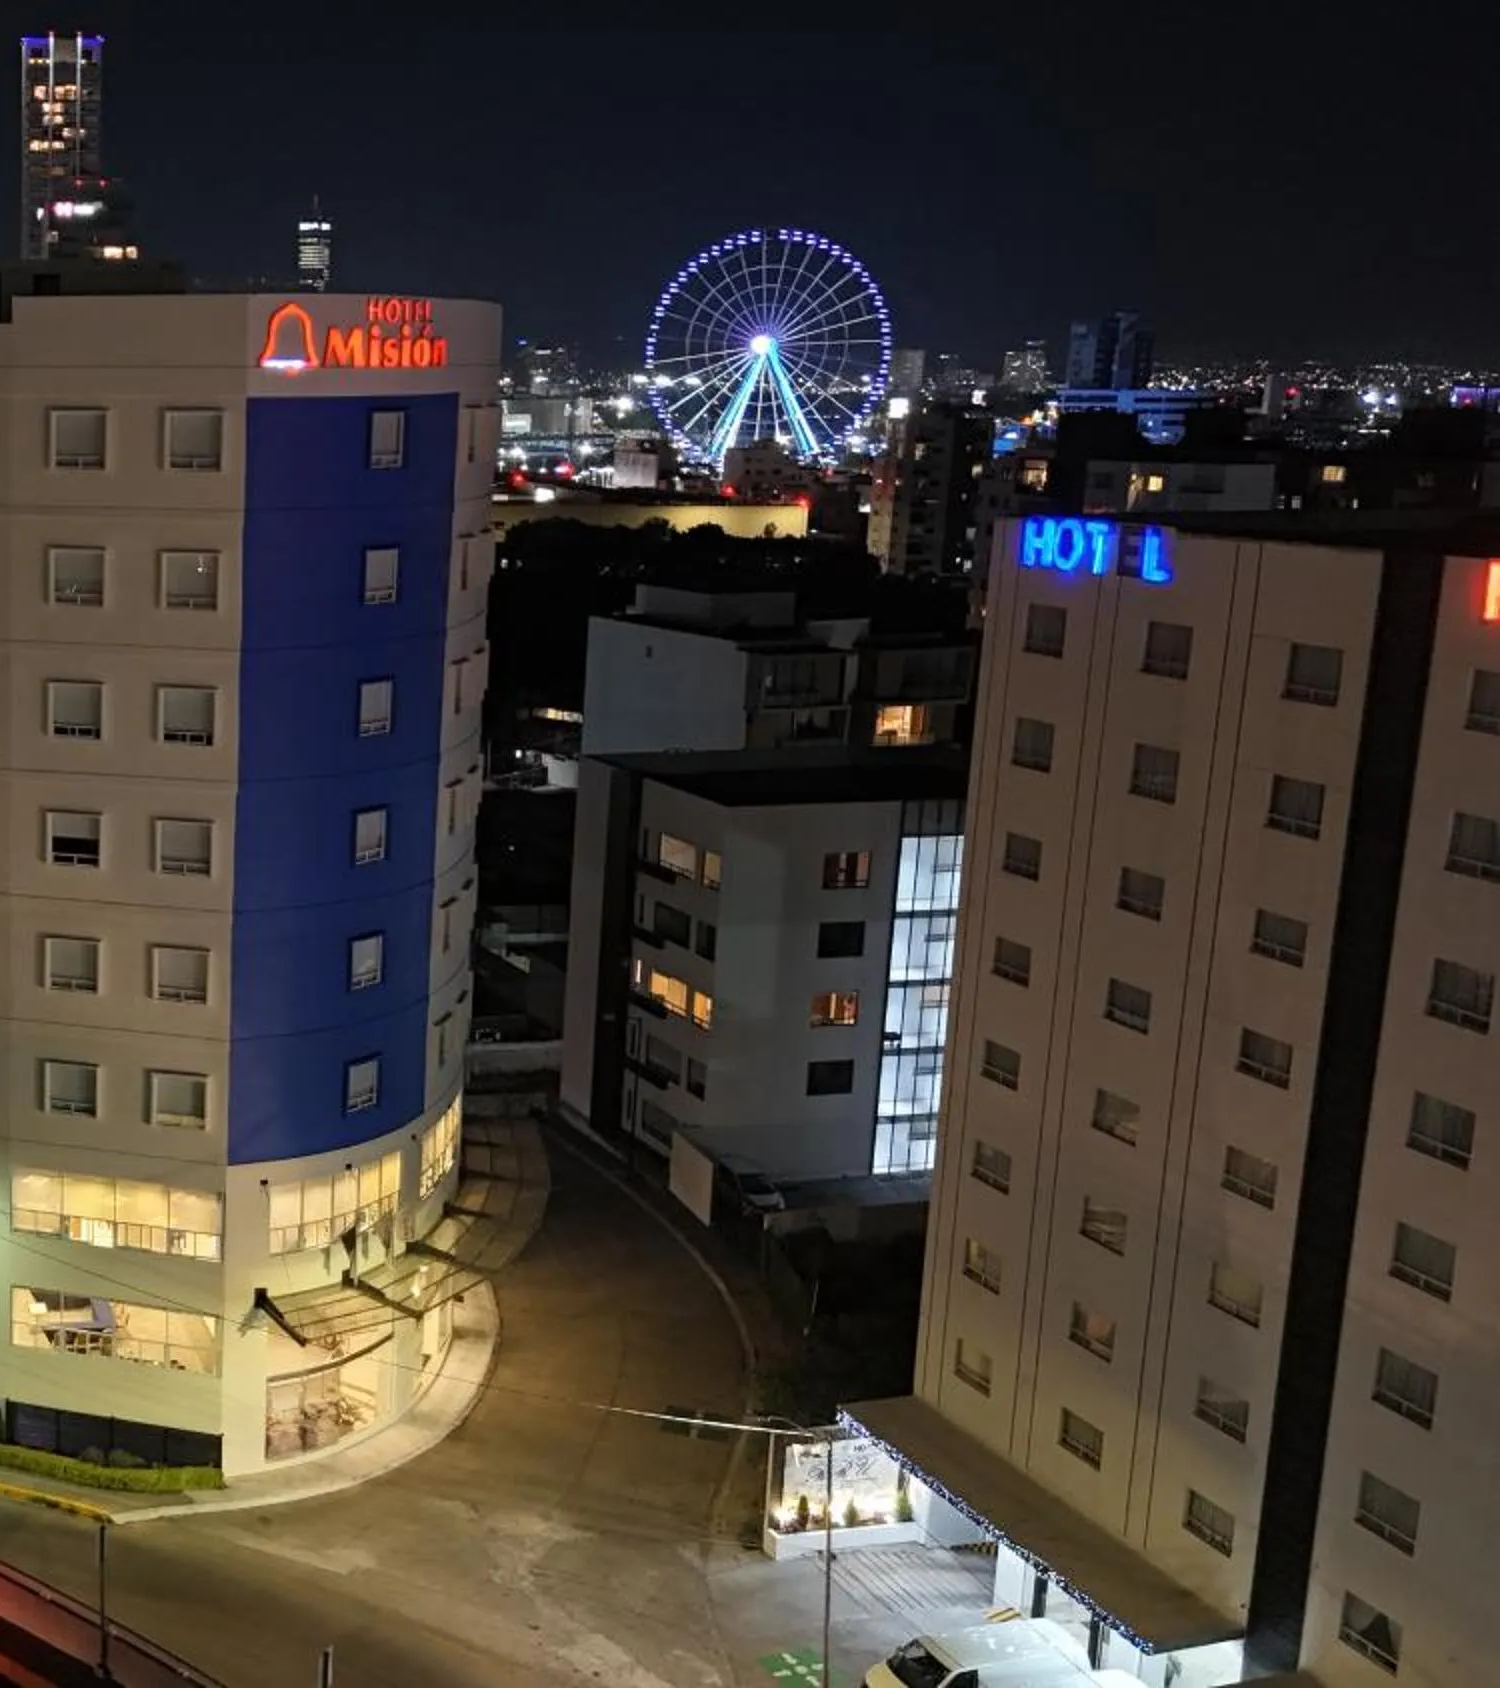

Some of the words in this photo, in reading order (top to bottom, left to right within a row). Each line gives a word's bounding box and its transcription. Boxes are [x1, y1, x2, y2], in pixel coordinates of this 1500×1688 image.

[367, 297, 432, 323] HOTEL
[323, 323, 447, 368] Misión
[1021, 517, 1173, 585] HOTEL
